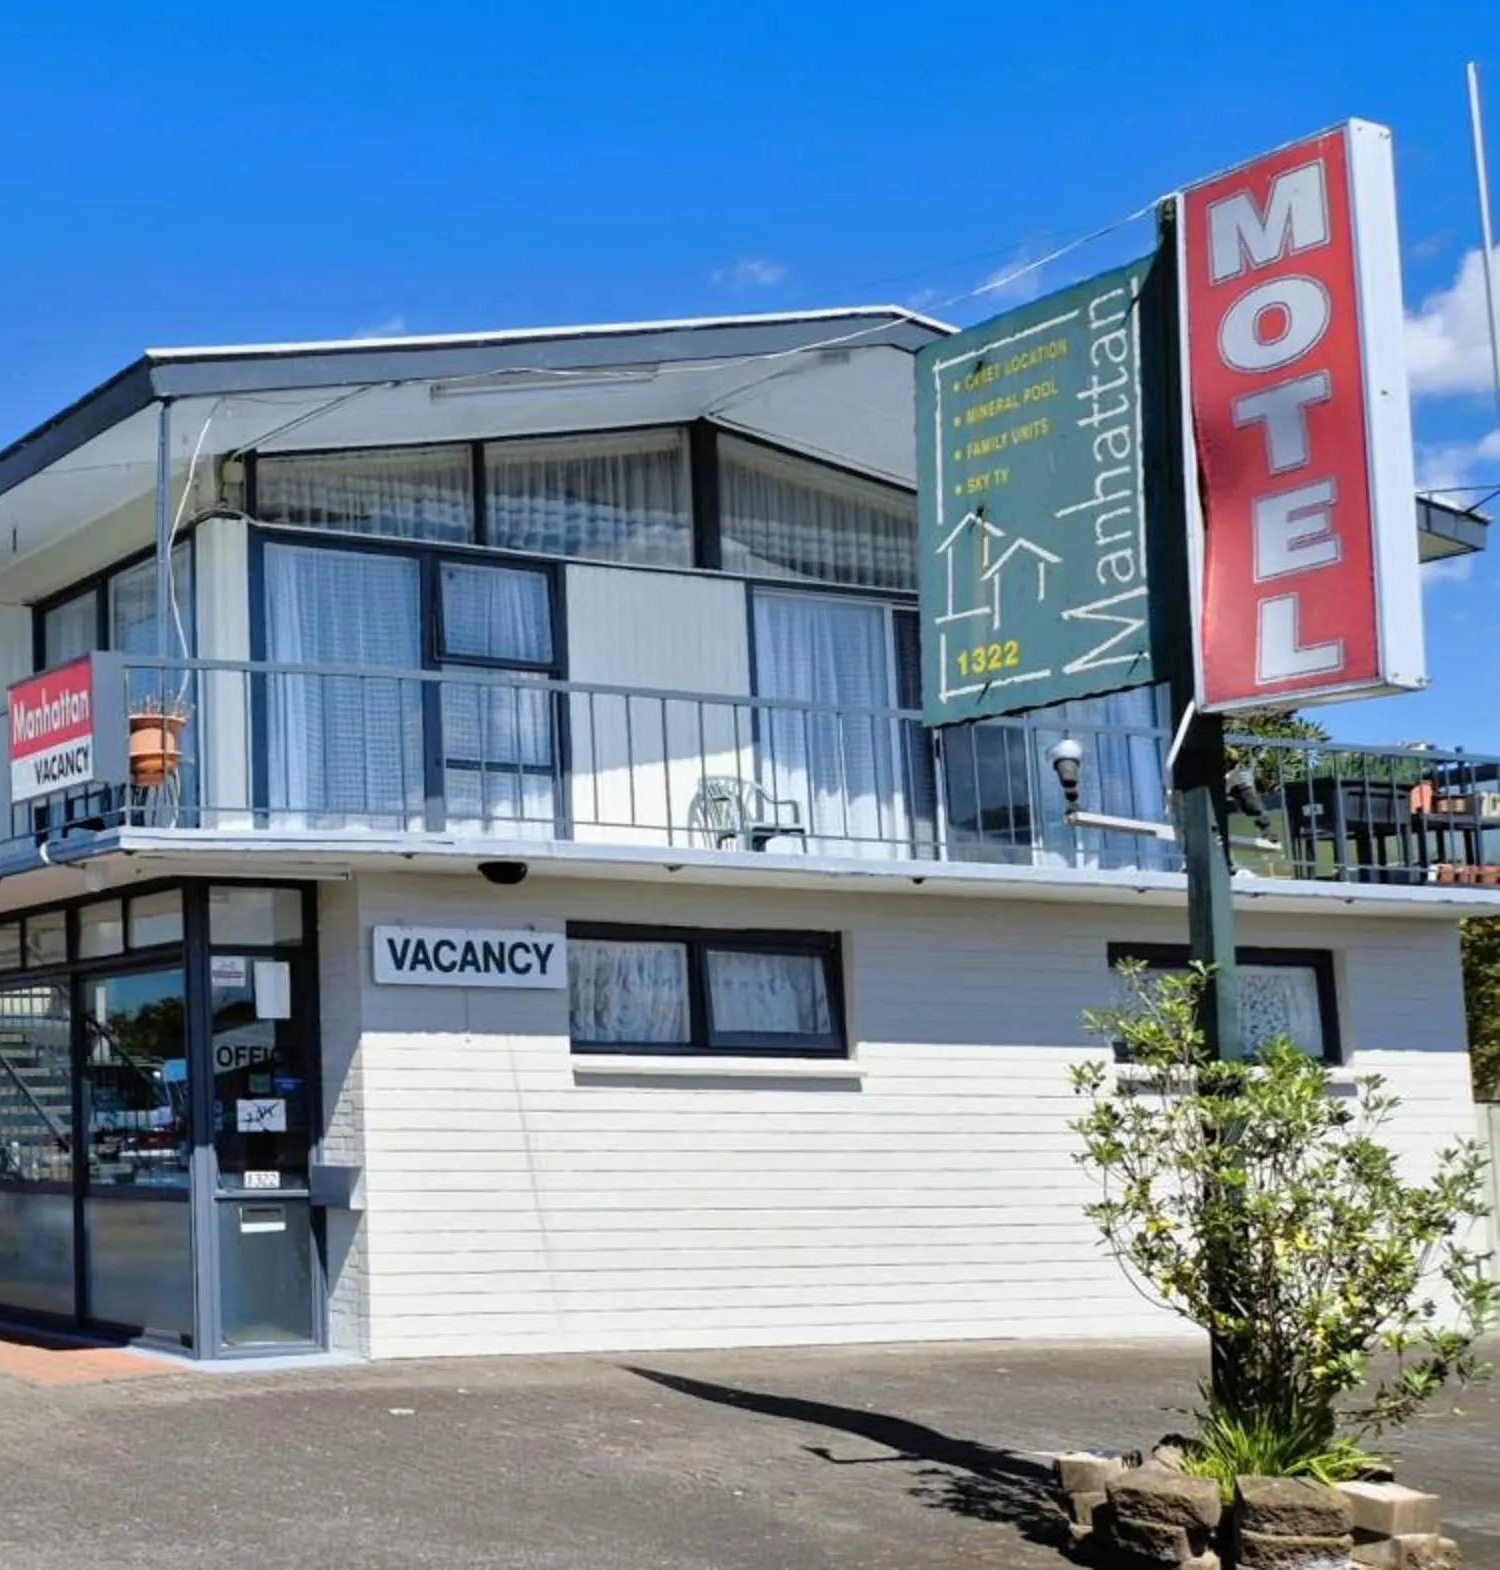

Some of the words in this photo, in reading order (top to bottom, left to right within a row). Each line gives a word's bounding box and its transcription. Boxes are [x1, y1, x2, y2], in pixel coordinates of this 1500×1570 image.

[1003, 338, 1069, 377] LOCATION
[966, 394, 1020, 425] MINERAL
[1023, 380, 1059, 403] POOL
[1208, 158, 1343, 685] MOTEL
[966, 431, 1008, 460] FAMILY
[1011, 417, 1049, 445] UNITS
[1055, 286, 1151, 676] Manhattan
[956, 639, 1020, 675] 1322
[12, 687, 90, 746] Manhattan
[33, 743, 90, 785] VACANCY
[386, 937, 555, 976] VACANCY
